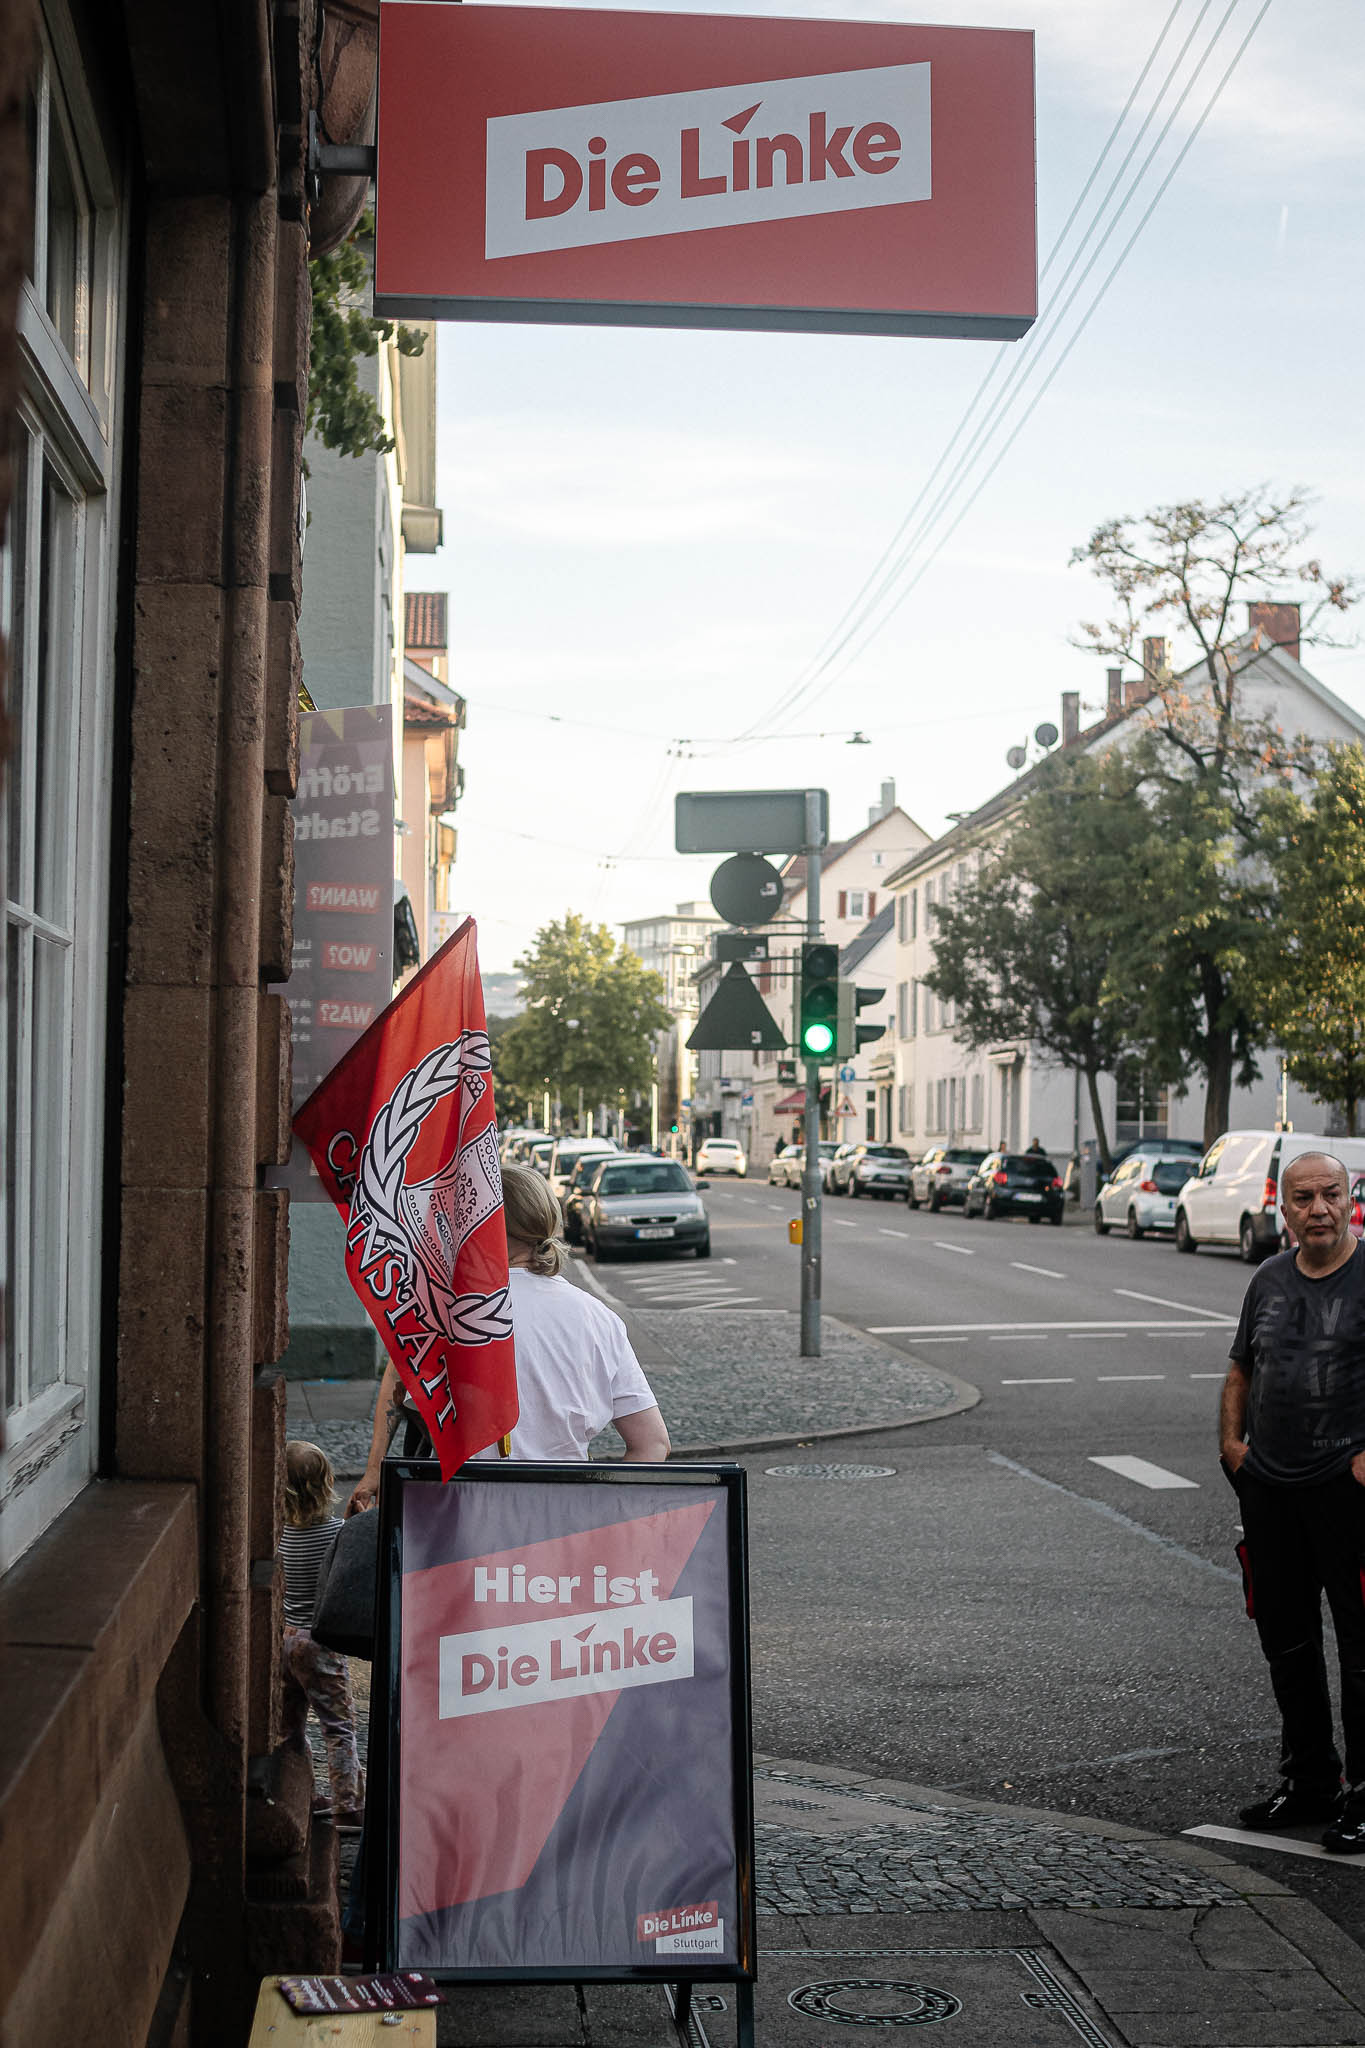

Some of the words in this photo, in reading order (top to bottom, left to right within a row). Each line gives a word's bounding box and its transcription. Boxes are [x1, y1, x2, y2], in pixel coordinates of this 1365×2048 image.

[525, 136, 661, 221] Die
[680, 100, 902, 200] Linke
[473, 1564, 581, 1604] Hier
[592, 1565, 660, 1605] ist
[461, 1646, 540, 1697] Die
[550, 1622, 677, 1681] Linke
[644, 1917, 669, 1935] Die
[671, 1909, 713, 1930] Linke
[673, 1938, 719, 1950] Stuttgart
